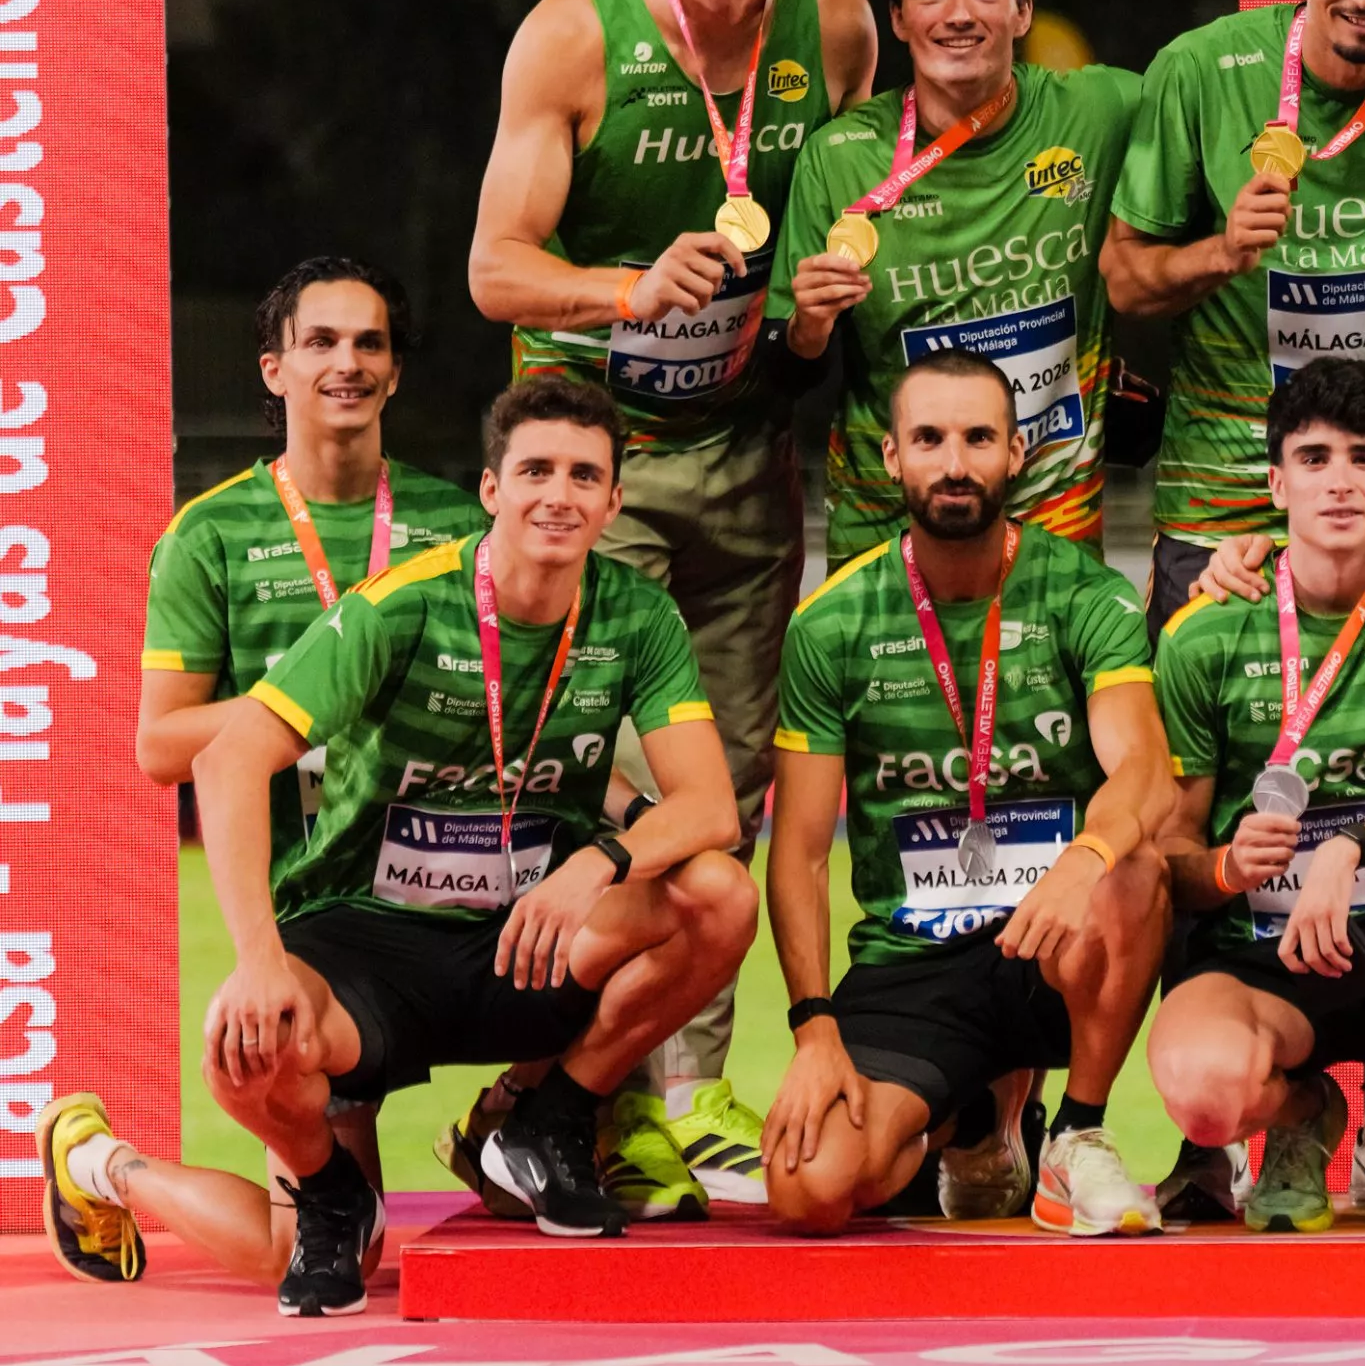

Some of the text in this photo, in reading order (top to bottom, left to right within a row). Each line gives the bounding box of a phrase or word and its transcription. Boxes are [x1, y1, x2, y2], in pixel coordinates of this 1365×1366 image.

[621, 62, 667, 75] VIATOR
[769, 66, 809, 89] intec
[647, 92, 688, 107] ZOITI
[634, 122, 805, 165] Hueca
[1025, 154, 1084, 189] intec
[894, 201, 944, 220] ZOITI
[886, 223, 1091, 303] Huesca
[1322, 295, 1336, 306] de
[727, 312, 748, 332] 20
[959, 308, 1066, 344] Diputación Provincial
[979, 338, 1018, 354] Málaga
[1029, 357, 1071, 392] 2026
[1018, 403, 1074, 443] ma
[1307, 651, 1342, 710] ATLETISMO
[979, 660, 996, 736] ATLETISMO
[1010, 808, 1061, 823] Provincial
[442, 834, 498, 846] de Málaga
[444, 823, 501, 834] Diputación
[386, 863, 489, 892] MÁLAGA
